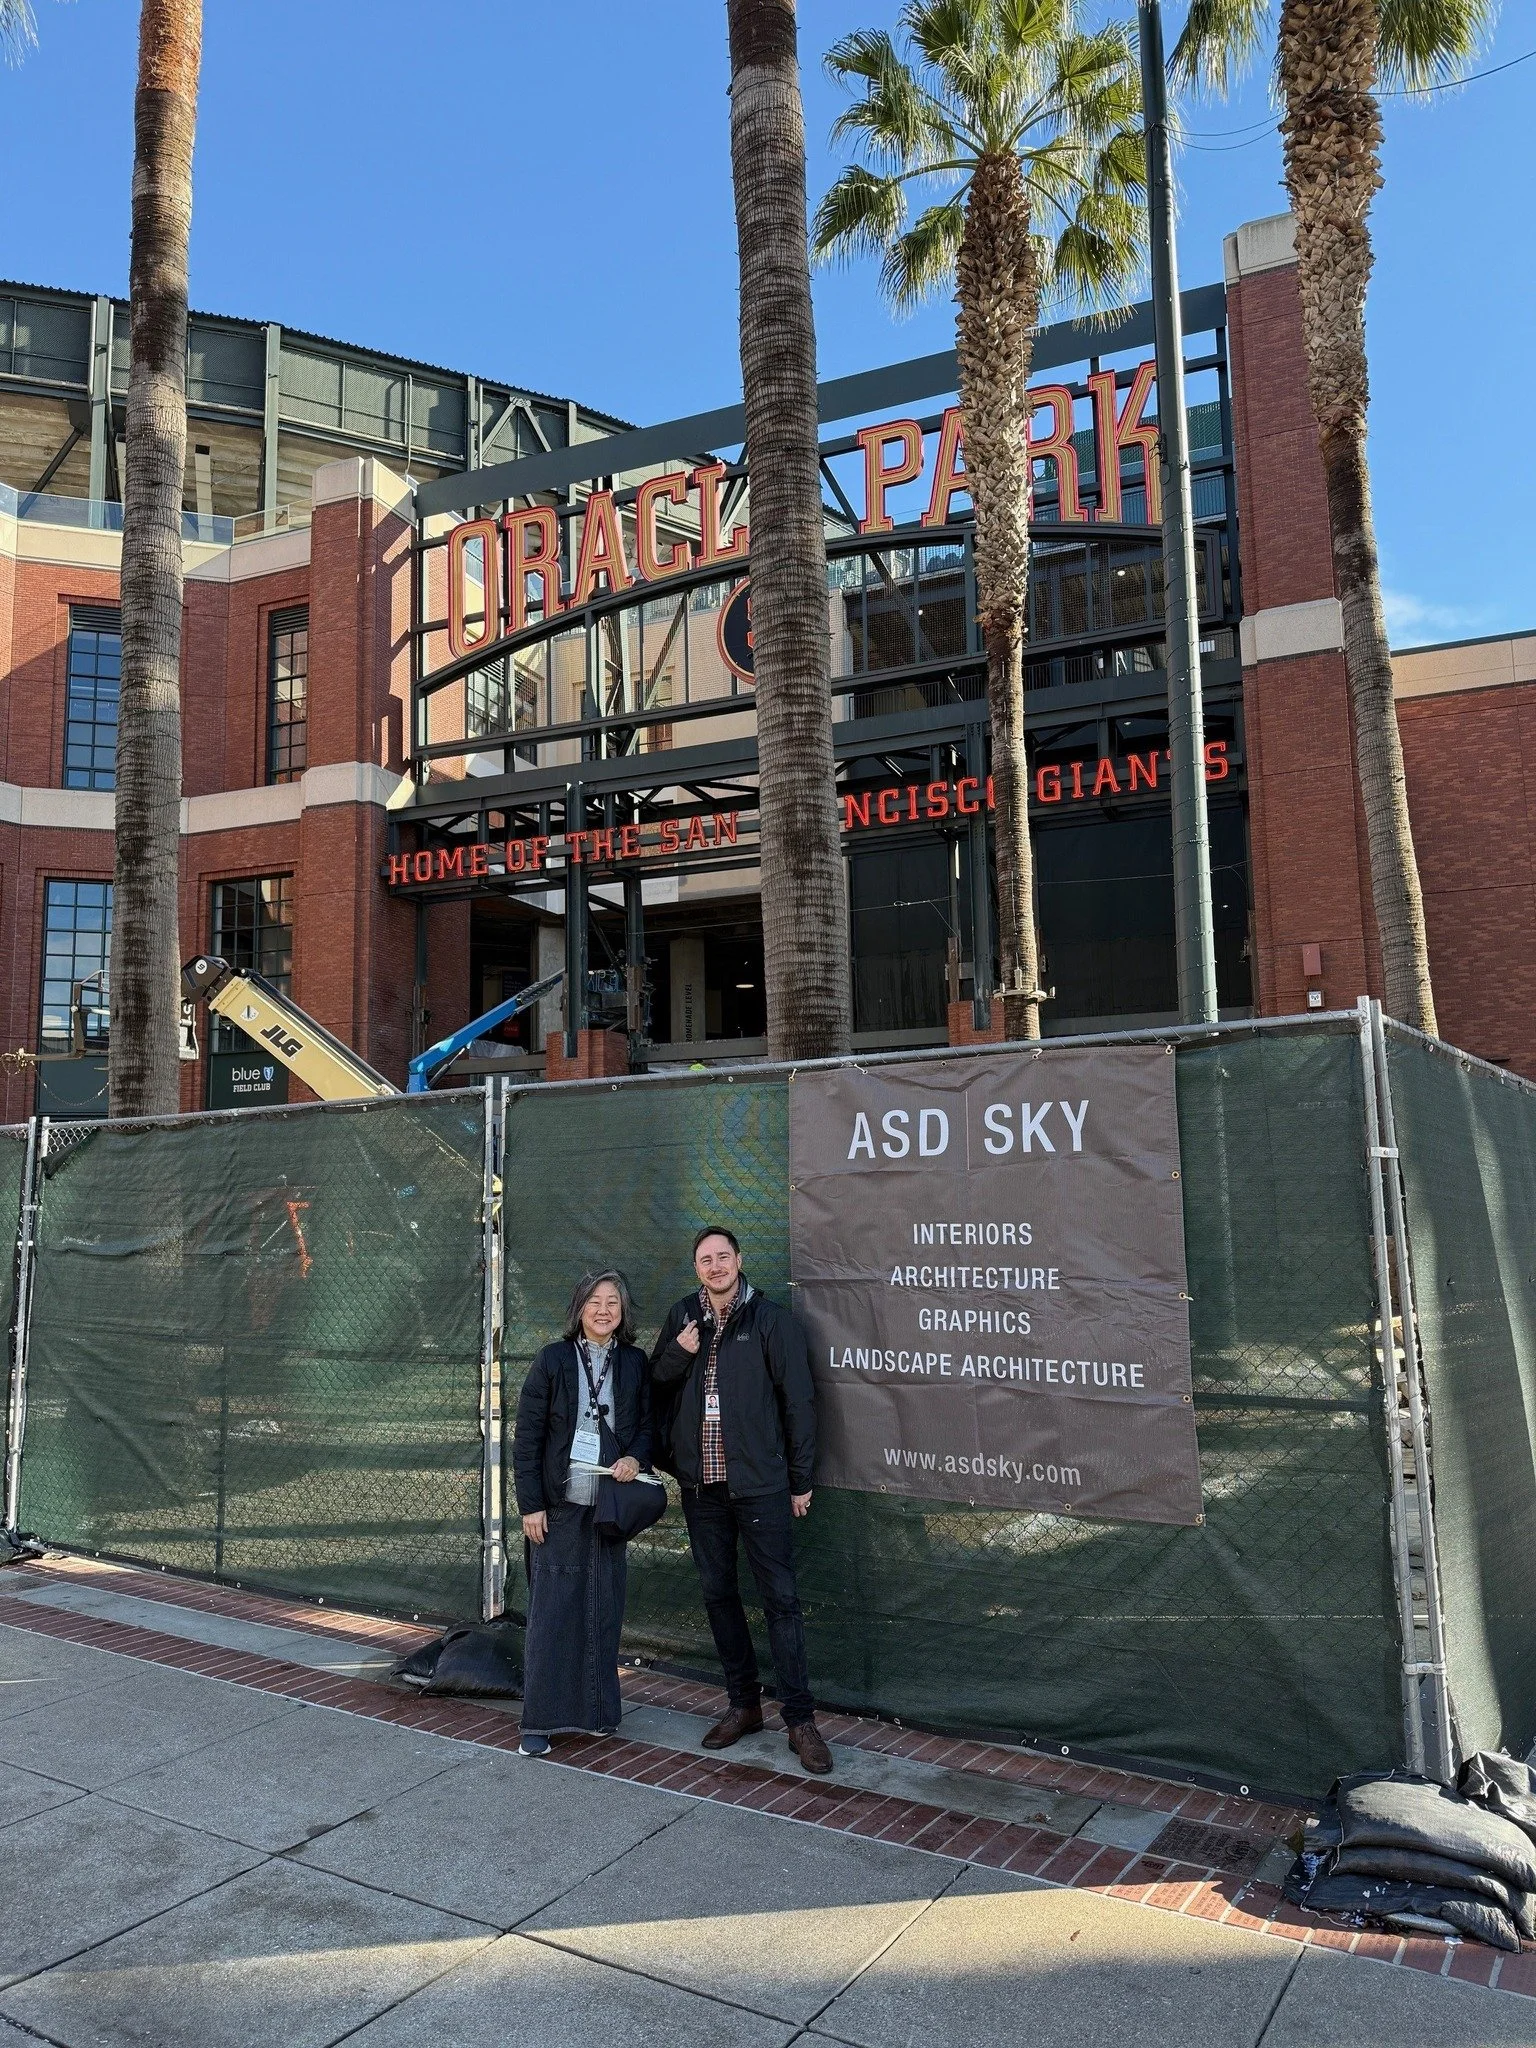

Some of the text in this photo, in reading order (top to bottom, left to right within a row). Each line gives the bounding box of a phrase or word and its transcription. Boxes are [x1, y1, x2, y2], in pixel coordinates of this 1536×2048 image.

[448, 463, 749, 659] ORACL
[389, 741, 1229, 886] HOME OF THE SAN NCISC GIANS
[685, 983, 693, 1042] ROMENADE LEVEL
[260, 1024, 305, 1058] JLG
[231, 1067, 260, 1082] blue
[233, 1083, 271, 1093] FIELD CLUB
[847, 1099, 1090, 1160] ASD SKY
[913, 1222, 1033, 1246] INTERIORS
[890, 1265, 1061, 1290] ARCHITECTURE
[918, 1308, 1031, 1335] GRAPHICS
[829, 1346, 1145, 1388] LANDSCAPE ARCHITECTURE
[884, 1446, 1082, 1487] www.asdsky.com
